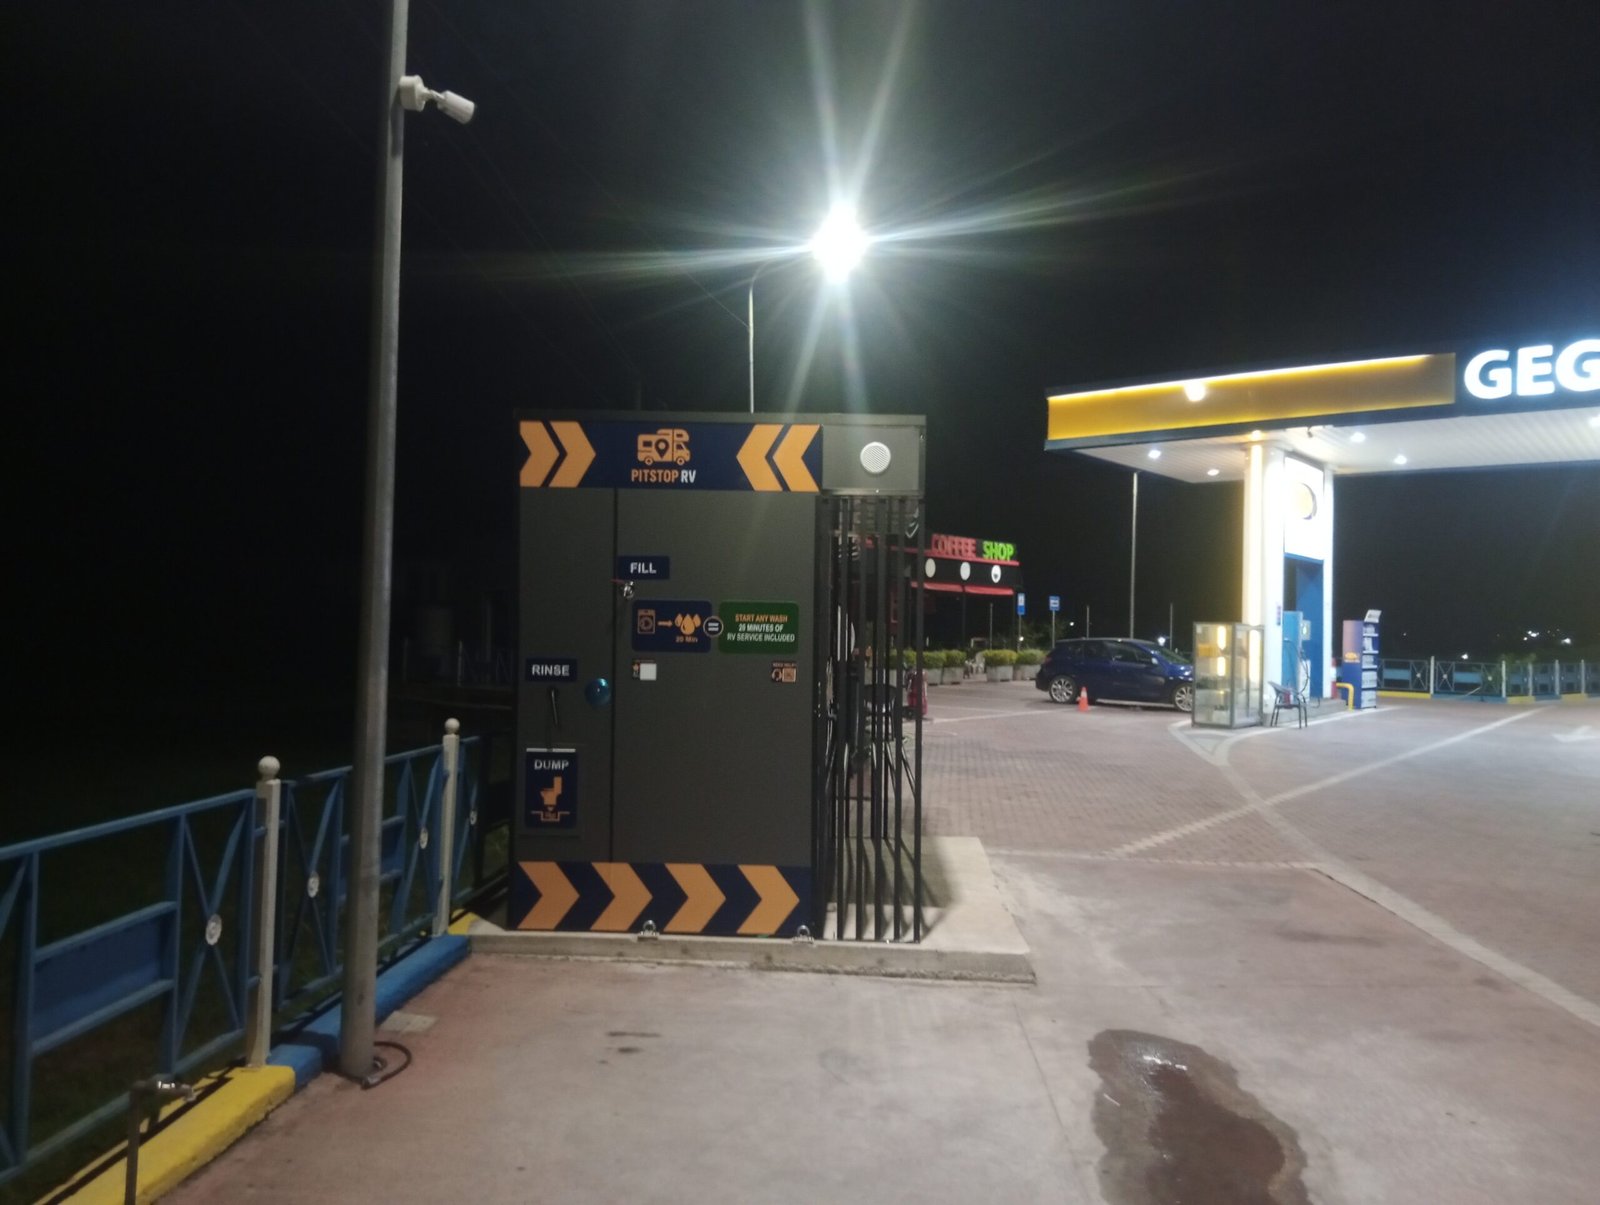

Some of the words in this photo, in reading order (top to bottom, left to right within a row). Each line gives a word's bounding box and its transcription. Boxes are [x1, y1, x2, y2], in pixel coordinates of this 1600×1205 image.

[631, 468, 679, 483] PITSTOP
[680, 469, 697, 484] RV
[932, 534, 977, 557] COFFEE
[982, 541, 1014, 561] SHOP
[630, 562, 657, 574] FILL
[735, 613, 755, 622] START
[755, 614, 769, 623] ANY
[769, 614, 788, 623] WASH
[746, 623, 774, 632] MINUTES
[774, 623, 784, 632] OF
[727, 632, 736, 641] RV
[736, 633, 763, 641] SERVICE
[763, 633, 795, 642] INCLUDED
[531, 664, 570, 676] RINSE
[534, 760, 569, 770] DUMP
